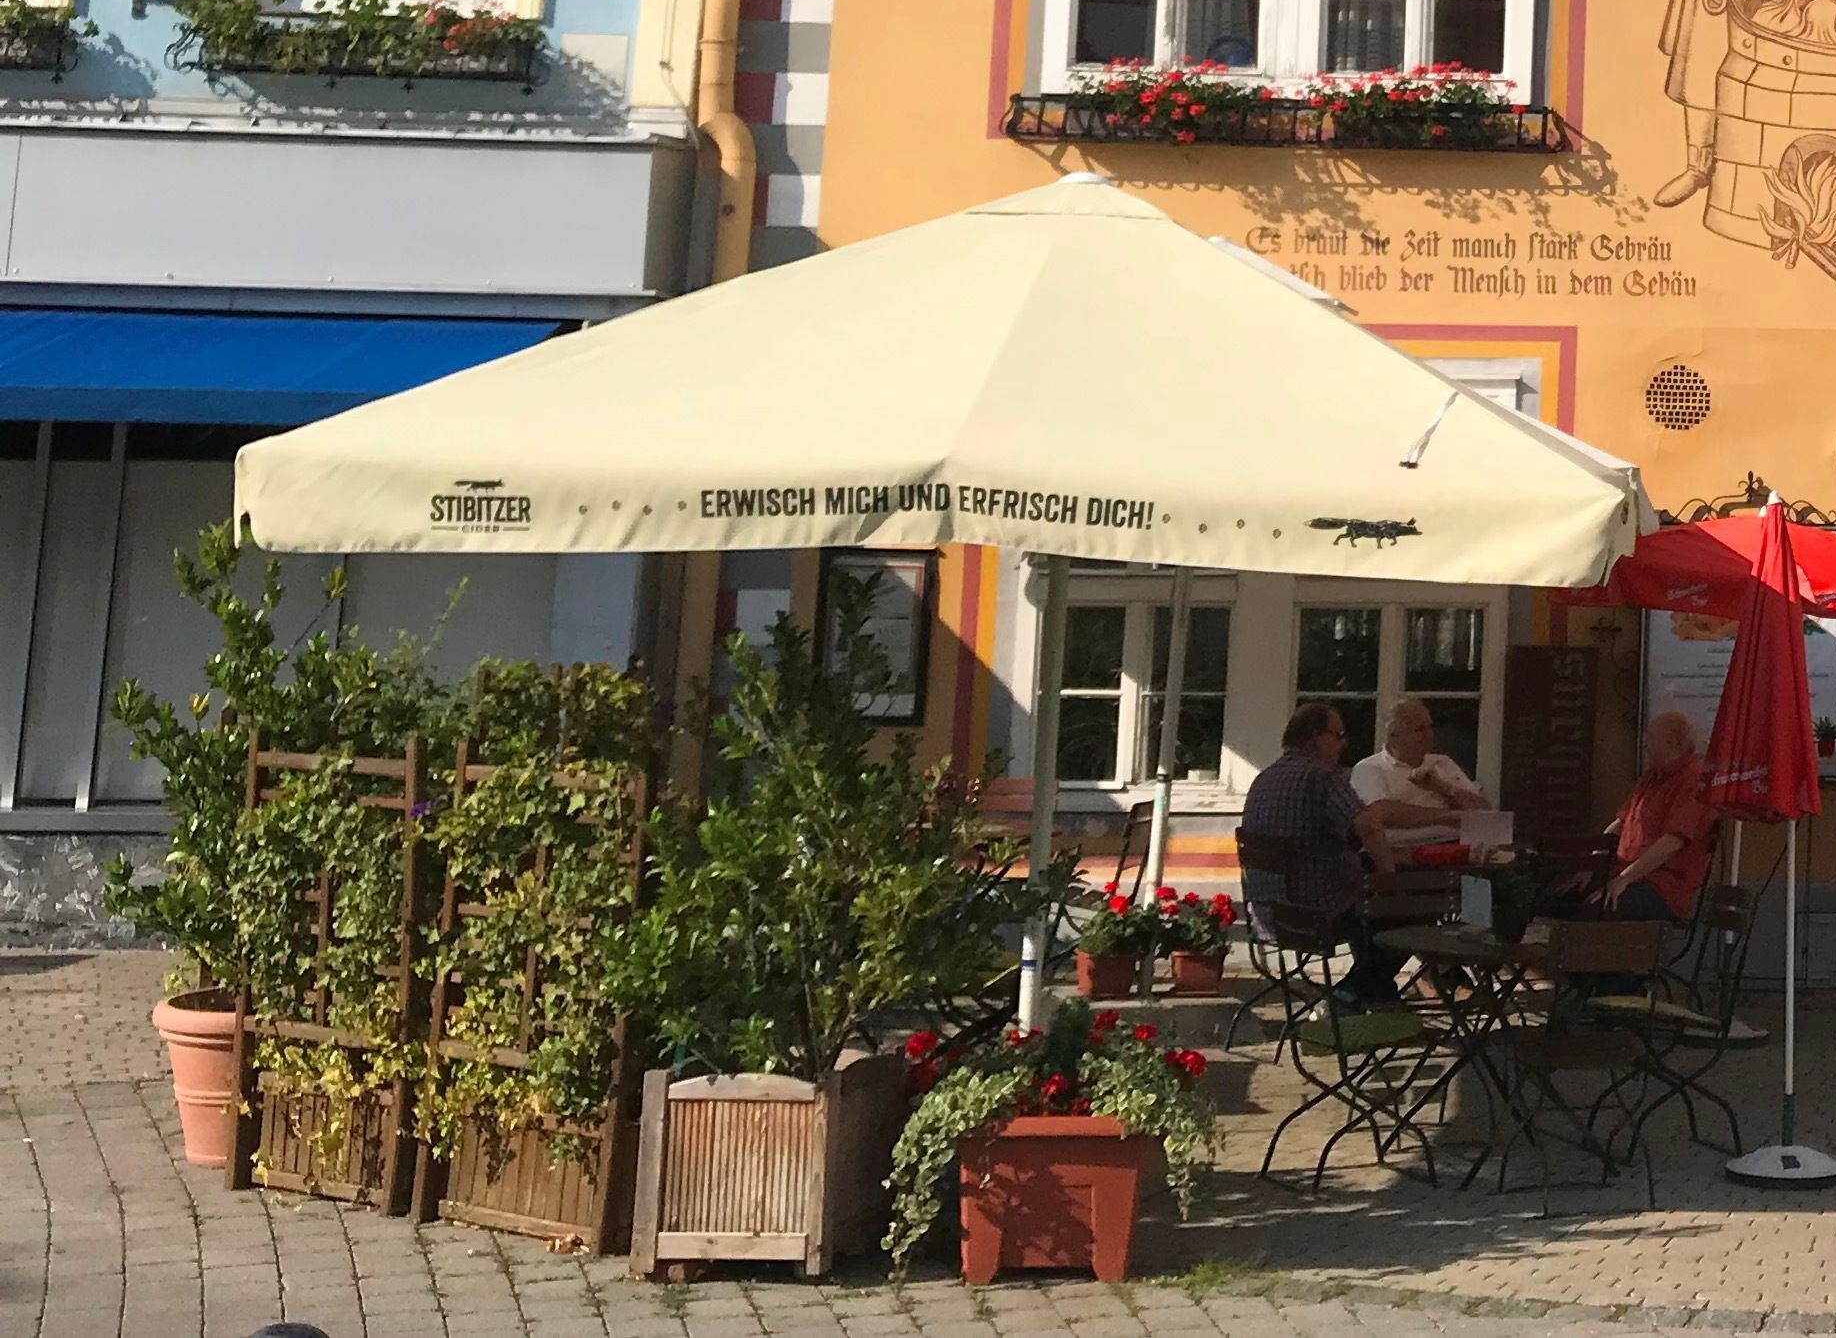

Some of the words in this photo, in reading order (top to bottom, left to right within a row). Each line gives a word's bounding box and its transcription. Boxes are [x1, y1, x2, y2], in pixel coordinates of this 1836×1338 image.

[1245, 226, 1283, 255] Es
[1400, 229, 1441, 262] Zeit
[1452, 233, 1517, 262] manch
[1590, 233, 1672, 262] Gebräu
[1339, 264, 1388, 292] blieb
[1399, 267, 1434, 292] der
[1536, 268, 1557, 294] in
[1568, 270, 1612, 296] dem
[1622, 270, 1697, 297] Gebäu
[430, 495, 531, 522] STIBITZER
[701, 487, 815, 518] ERWISCH
[825, 486, 889, 515] MICH
[899, 483, 950, 512] UND
[958, 486, 1079, 525] ERFRISCH
[1086, 497, 1155, 530] DICH!
